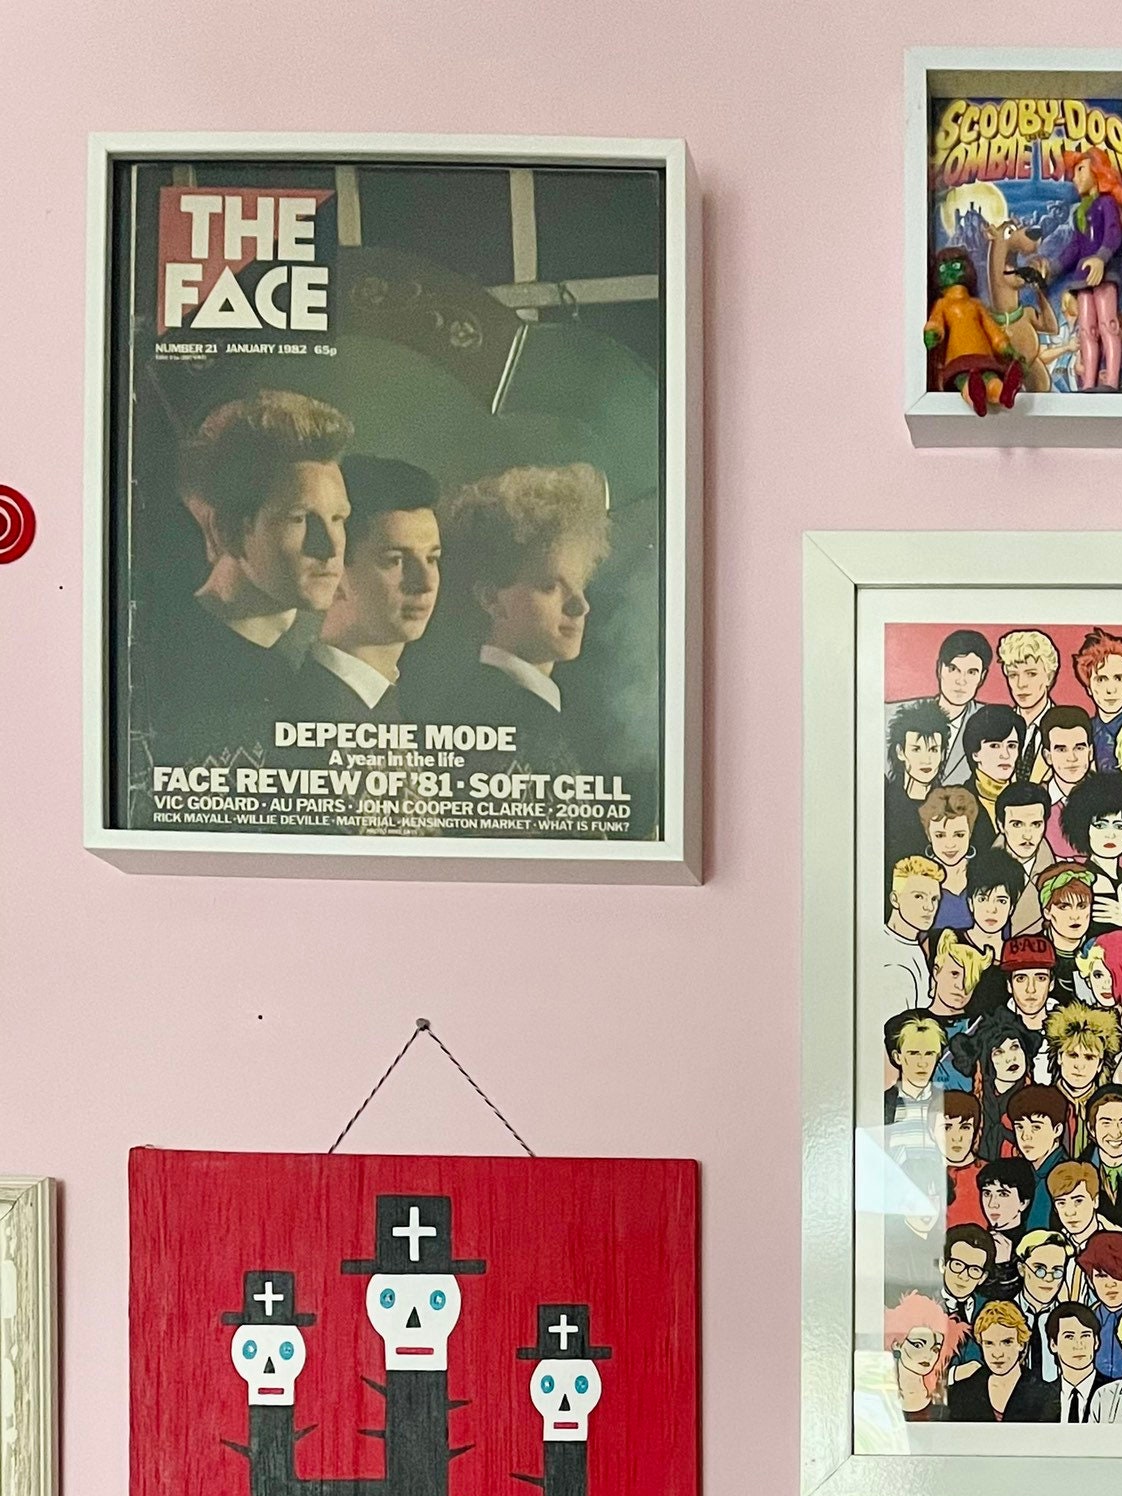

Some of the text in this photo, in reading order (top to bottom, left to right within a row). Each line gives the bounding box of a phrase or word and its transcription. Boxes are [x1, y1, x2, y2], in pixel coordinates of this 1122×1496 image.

[180, 194, 316, 261] THE
[164, 262, 329, 331] FACE
[155, 343, 338, 357] NUMBER 21 JANUARY 1982 65p
[275, 721, 517, 751] DEPECHE MODE
[329, 750, 343, 765] A
[345, 752, 385, 769] year
[405, 752, 435, 767] the
[437, 752, 465, 768] life
[153, 767, 230, 793] FACE
[237, 768, 362, 795] REVIEW
[365, 771, 406, 796] OF
[469, 773, 551, 799] SOFT
[553, 775, 631, 801] CELL
[153, 795, 631, 819] VIC GODARD AU PAIRS JOHN COOPER CLARKE 2000 AD
[153, 812, 630, 832] RICK MAYALL WILLIE DEVILLE MATERIAL KENSINGTON MARKET WHAT IS FUNK?
